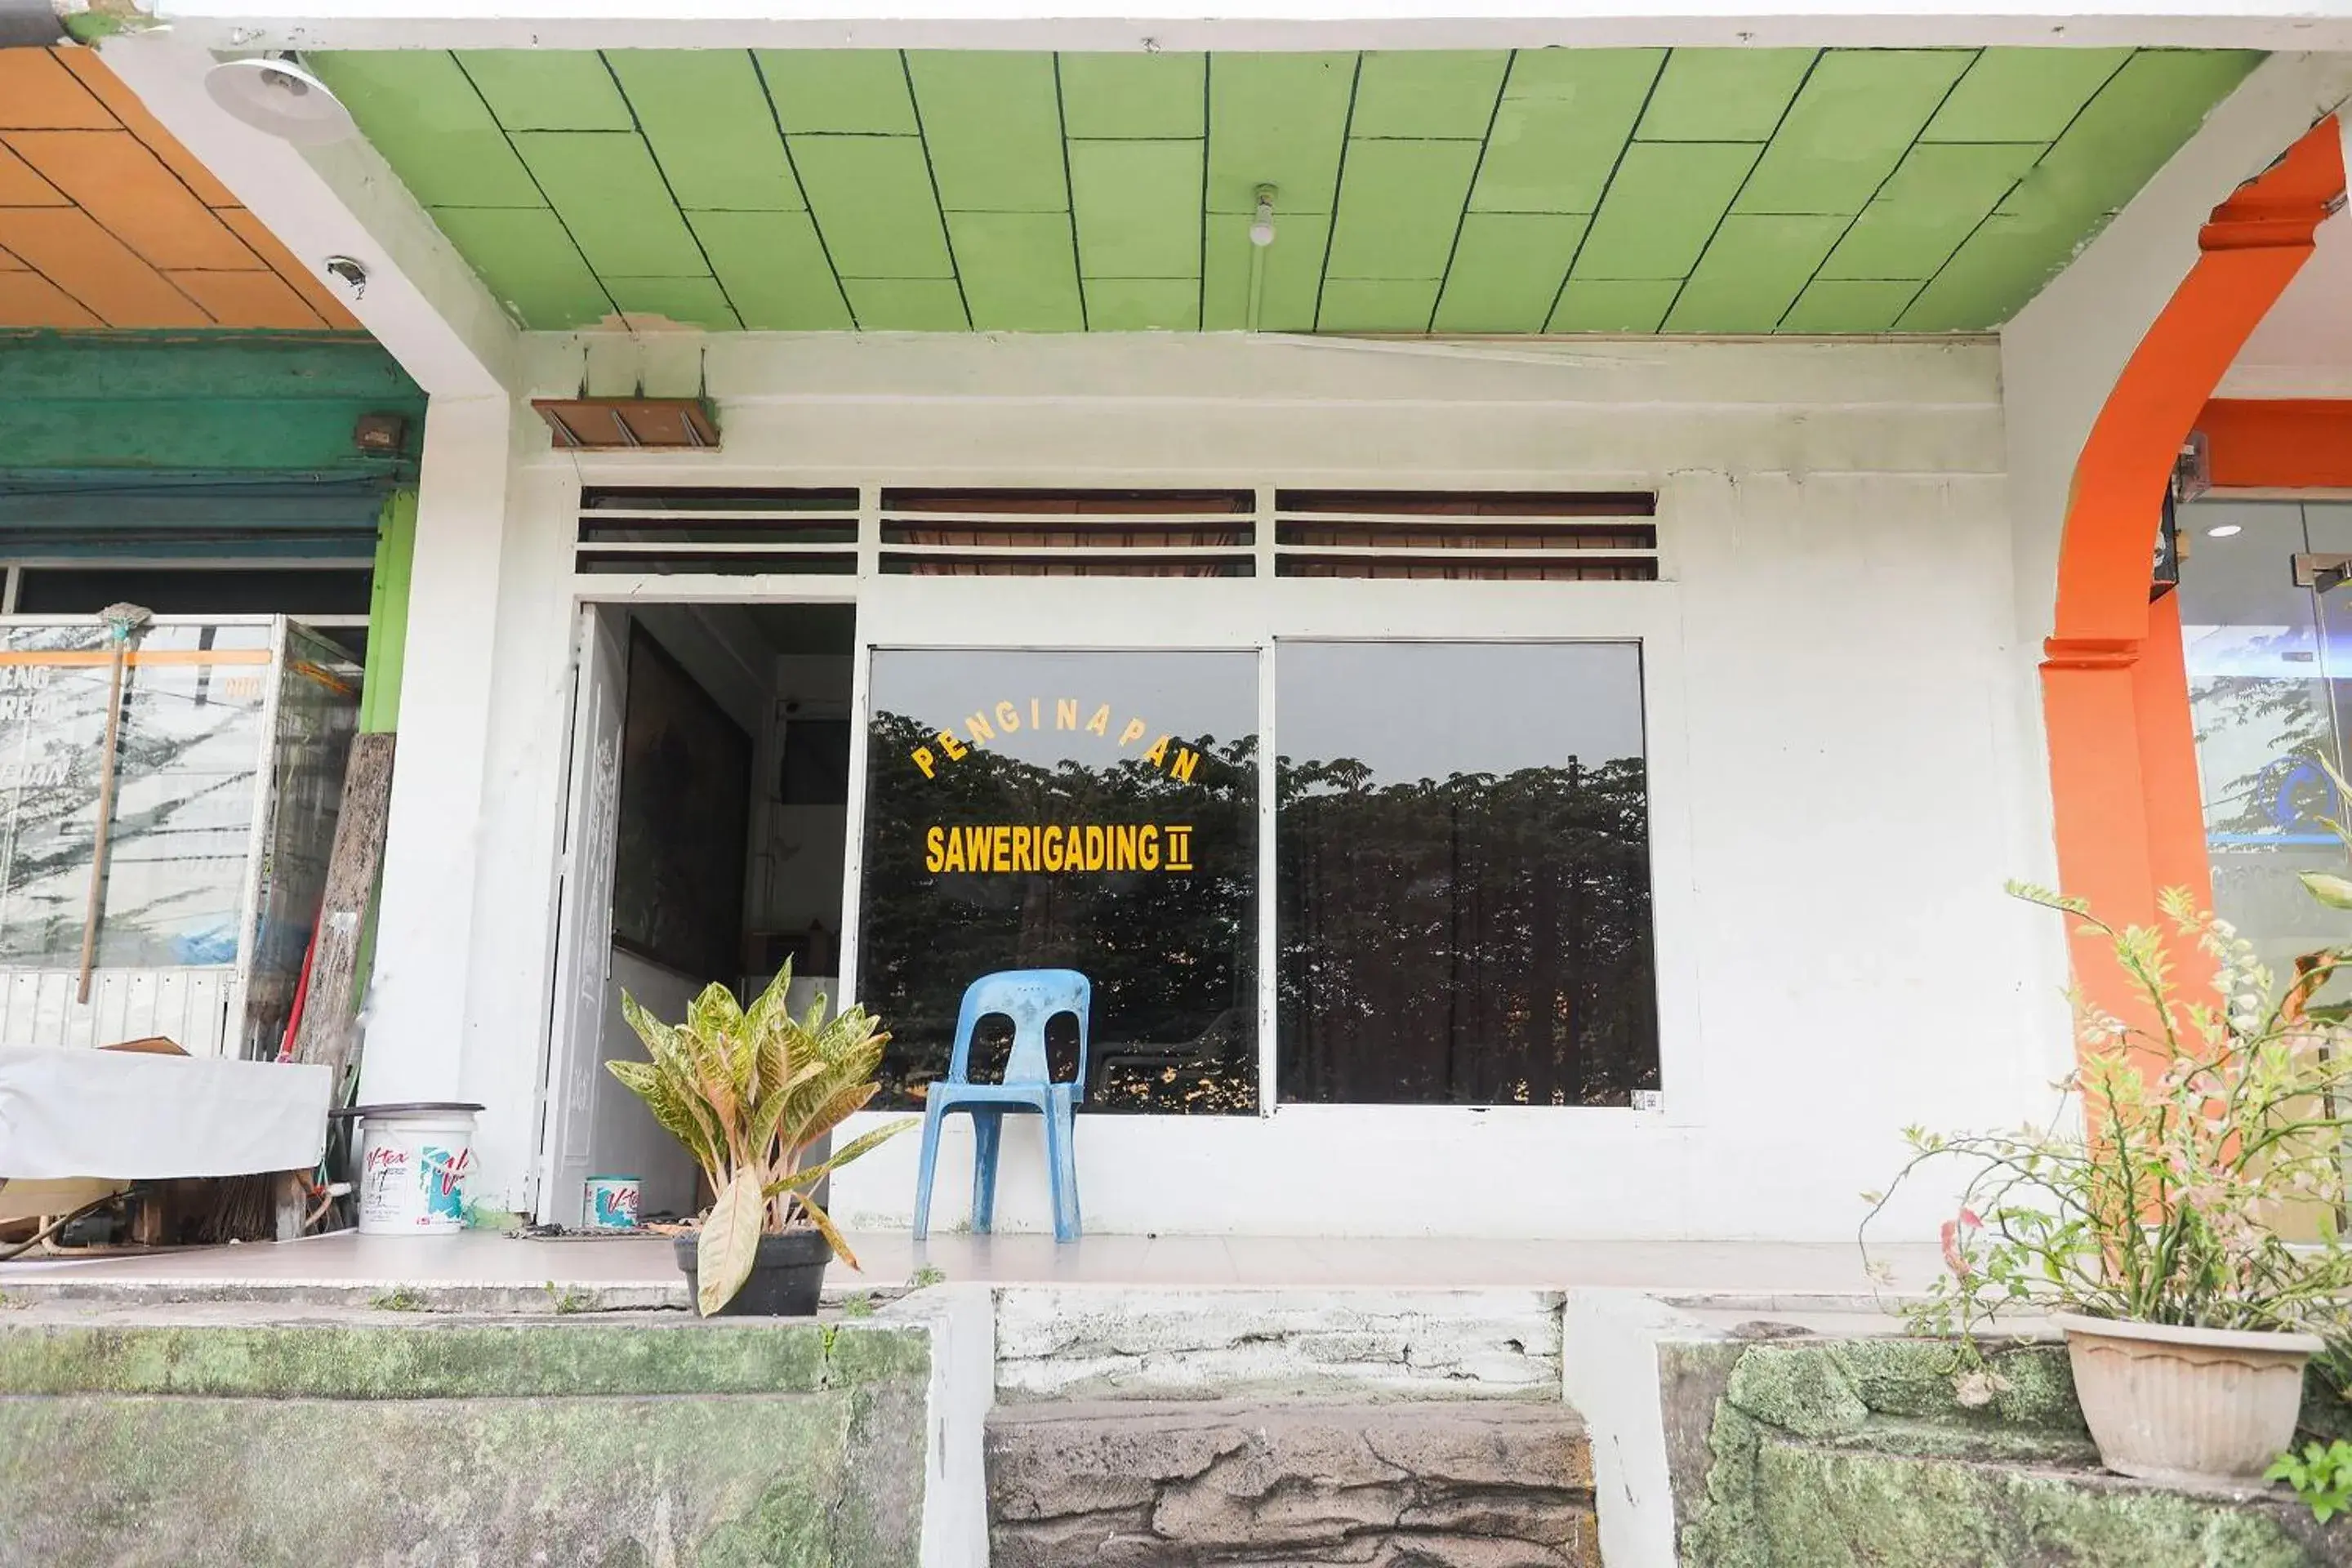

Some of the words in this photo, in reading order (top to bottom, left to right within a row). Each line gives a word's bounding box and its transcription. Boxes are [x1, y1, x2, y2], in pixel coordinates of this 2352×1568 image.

[911, 697, 1200, 784] PENGINAPAN
[926, 824, 1160, 873] SAWERIGADING
[1165, 826, 1193, 871] II
